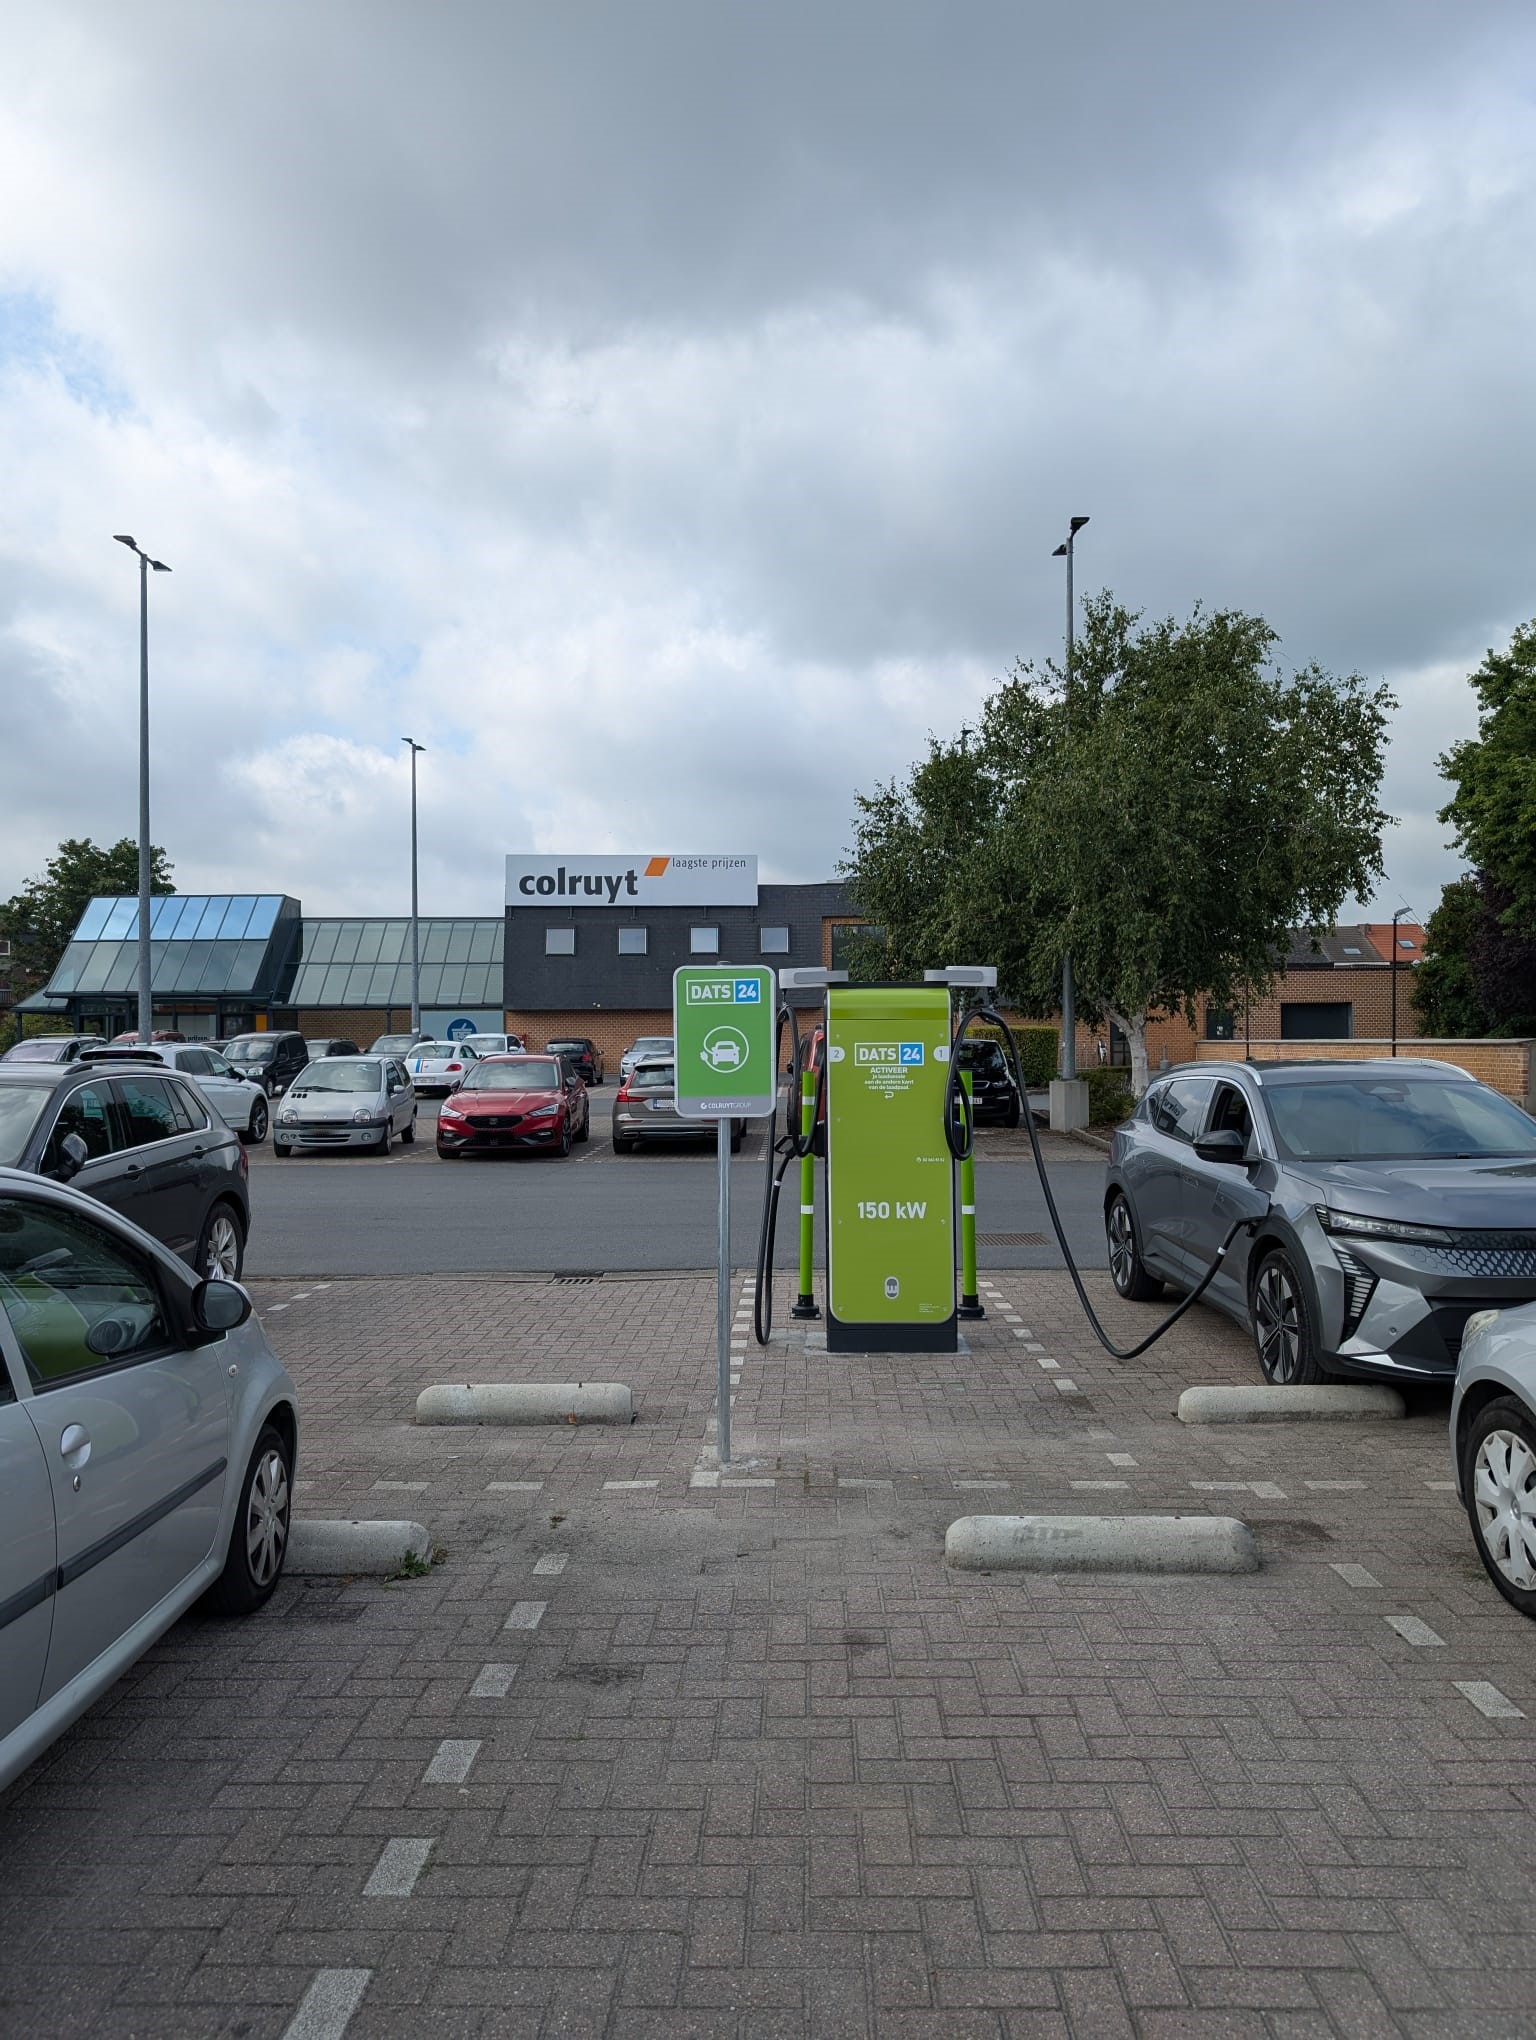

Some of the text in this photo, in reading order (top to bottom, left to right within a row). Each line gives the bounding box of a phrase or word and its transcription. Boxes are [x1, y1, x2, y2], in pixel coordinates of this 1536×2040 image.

[672, 858, 746, 869] laagste prijzen
[519, 867, 638, 903] colruyt
[691, 984, 757, 999] DATS 24
[834, 1050, 840, 1058] 2
[859, 1047, 921, 1060] DATS 24
[857, 1201, 927, 1219] 150 kW
